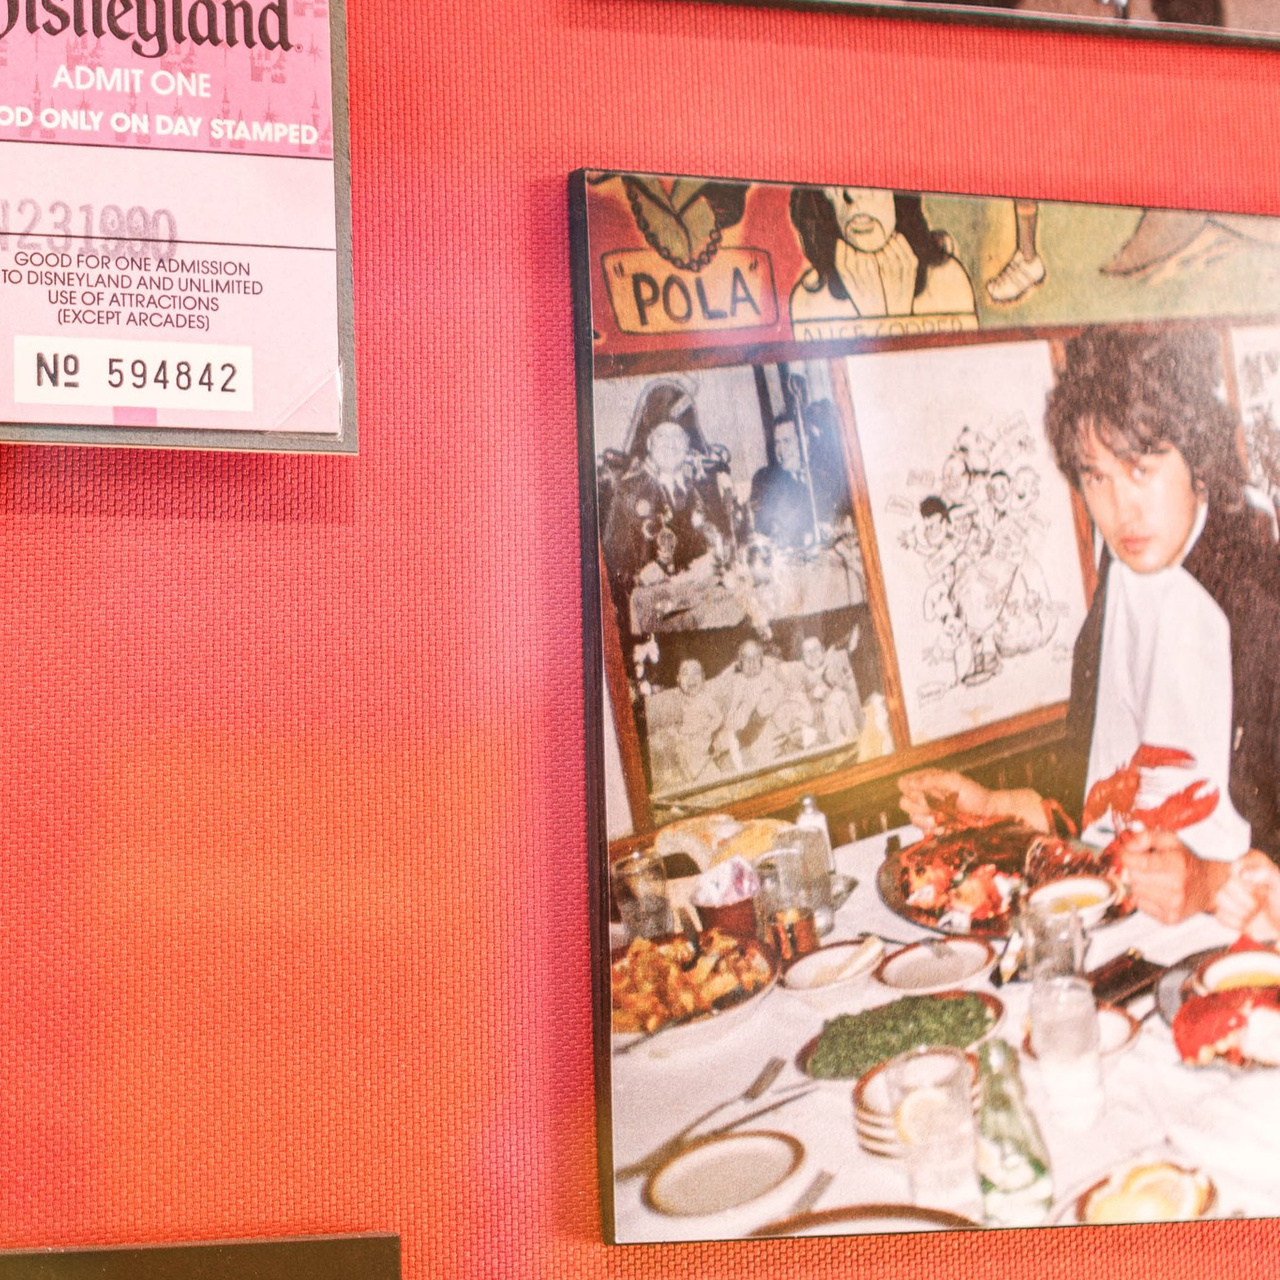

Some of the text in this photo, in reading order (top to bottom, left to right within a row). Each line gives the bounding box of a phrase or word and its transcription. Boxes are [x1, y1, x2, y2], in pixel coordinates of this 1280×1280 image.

[52, 64, 211, 98] ADMIT ONE
[40, 108, 104, 132] ONLY
[110, 112, 148, 134] ON
[156, 115, 202, 137] DAY
[210, 119, 318, 144] STAMPED
[14, 252, 250, 276] GOOD FOR ONE ADMISSION
[2, 269, 263, 295] TO DISNEYLAND AND UNLIMITED
[48, 290, 219, 312] USE OF ATTRACTIONS
[57, 309, 210, 332] (EXCEPT ARCADES)
[108, 358, 237, 393] 594842
